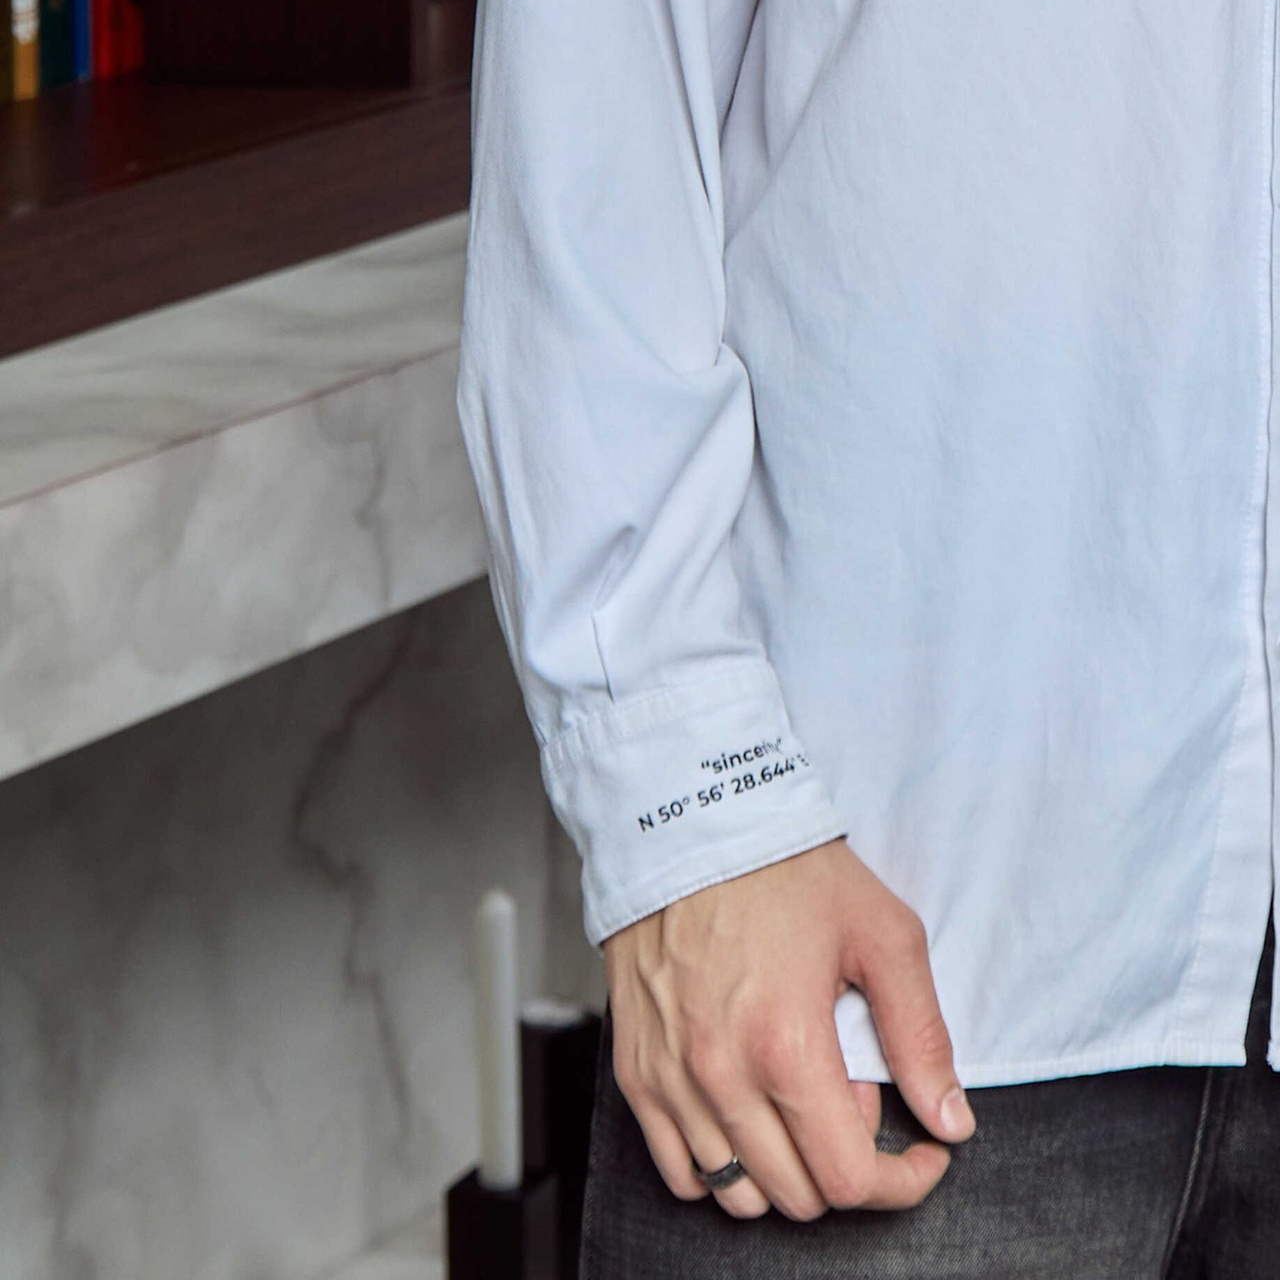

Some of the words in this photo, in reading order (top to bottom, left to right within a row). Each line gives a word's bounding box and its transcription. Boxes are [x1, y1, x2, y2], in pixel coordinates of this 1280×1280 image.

[638, 811, 654, 833] N
[658, 796, 690, 824] 50°
[697, 782, 724, 808] 56'
